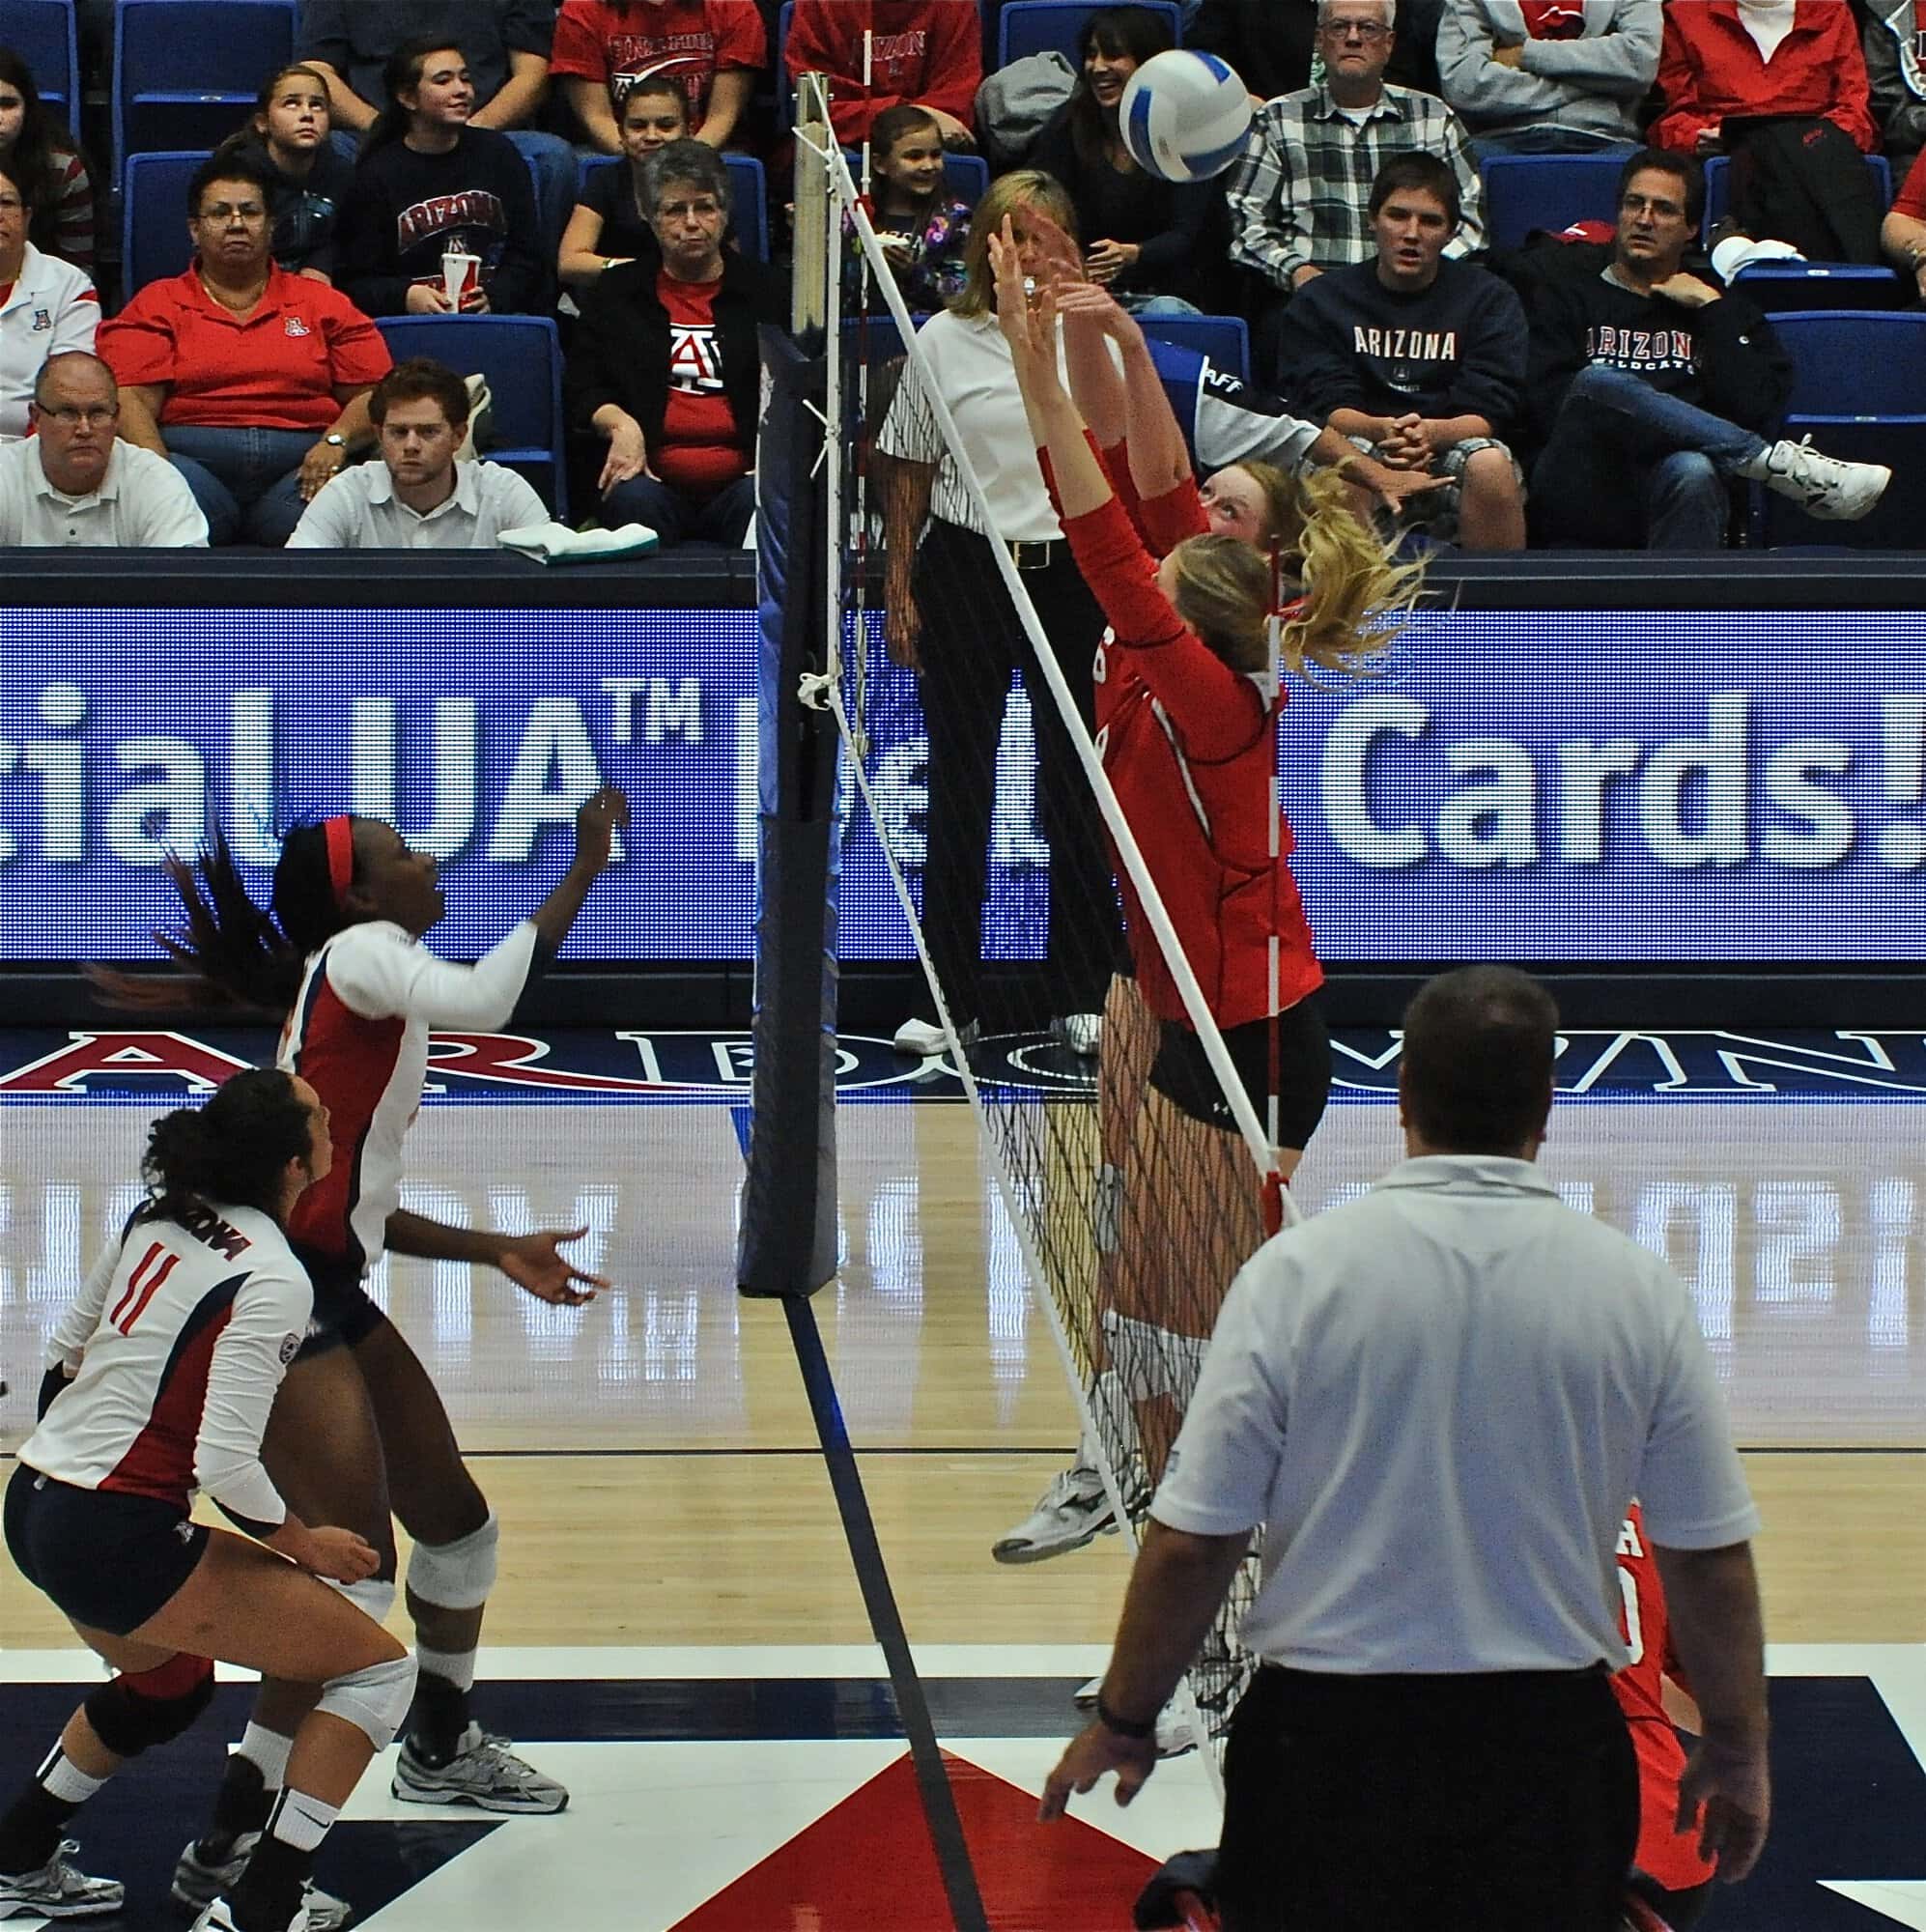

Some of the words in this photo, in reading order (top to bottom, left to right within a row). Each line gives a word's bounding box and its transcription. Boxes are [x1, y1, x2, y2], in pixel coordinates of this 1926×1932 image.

[1353, 326, 1456, 361] ARIZONA
[1585, 325, 1700, 361] RIZON
[1320, 690, 1926, 869] Cards!
[108, 1240, 182, 1338] 11
